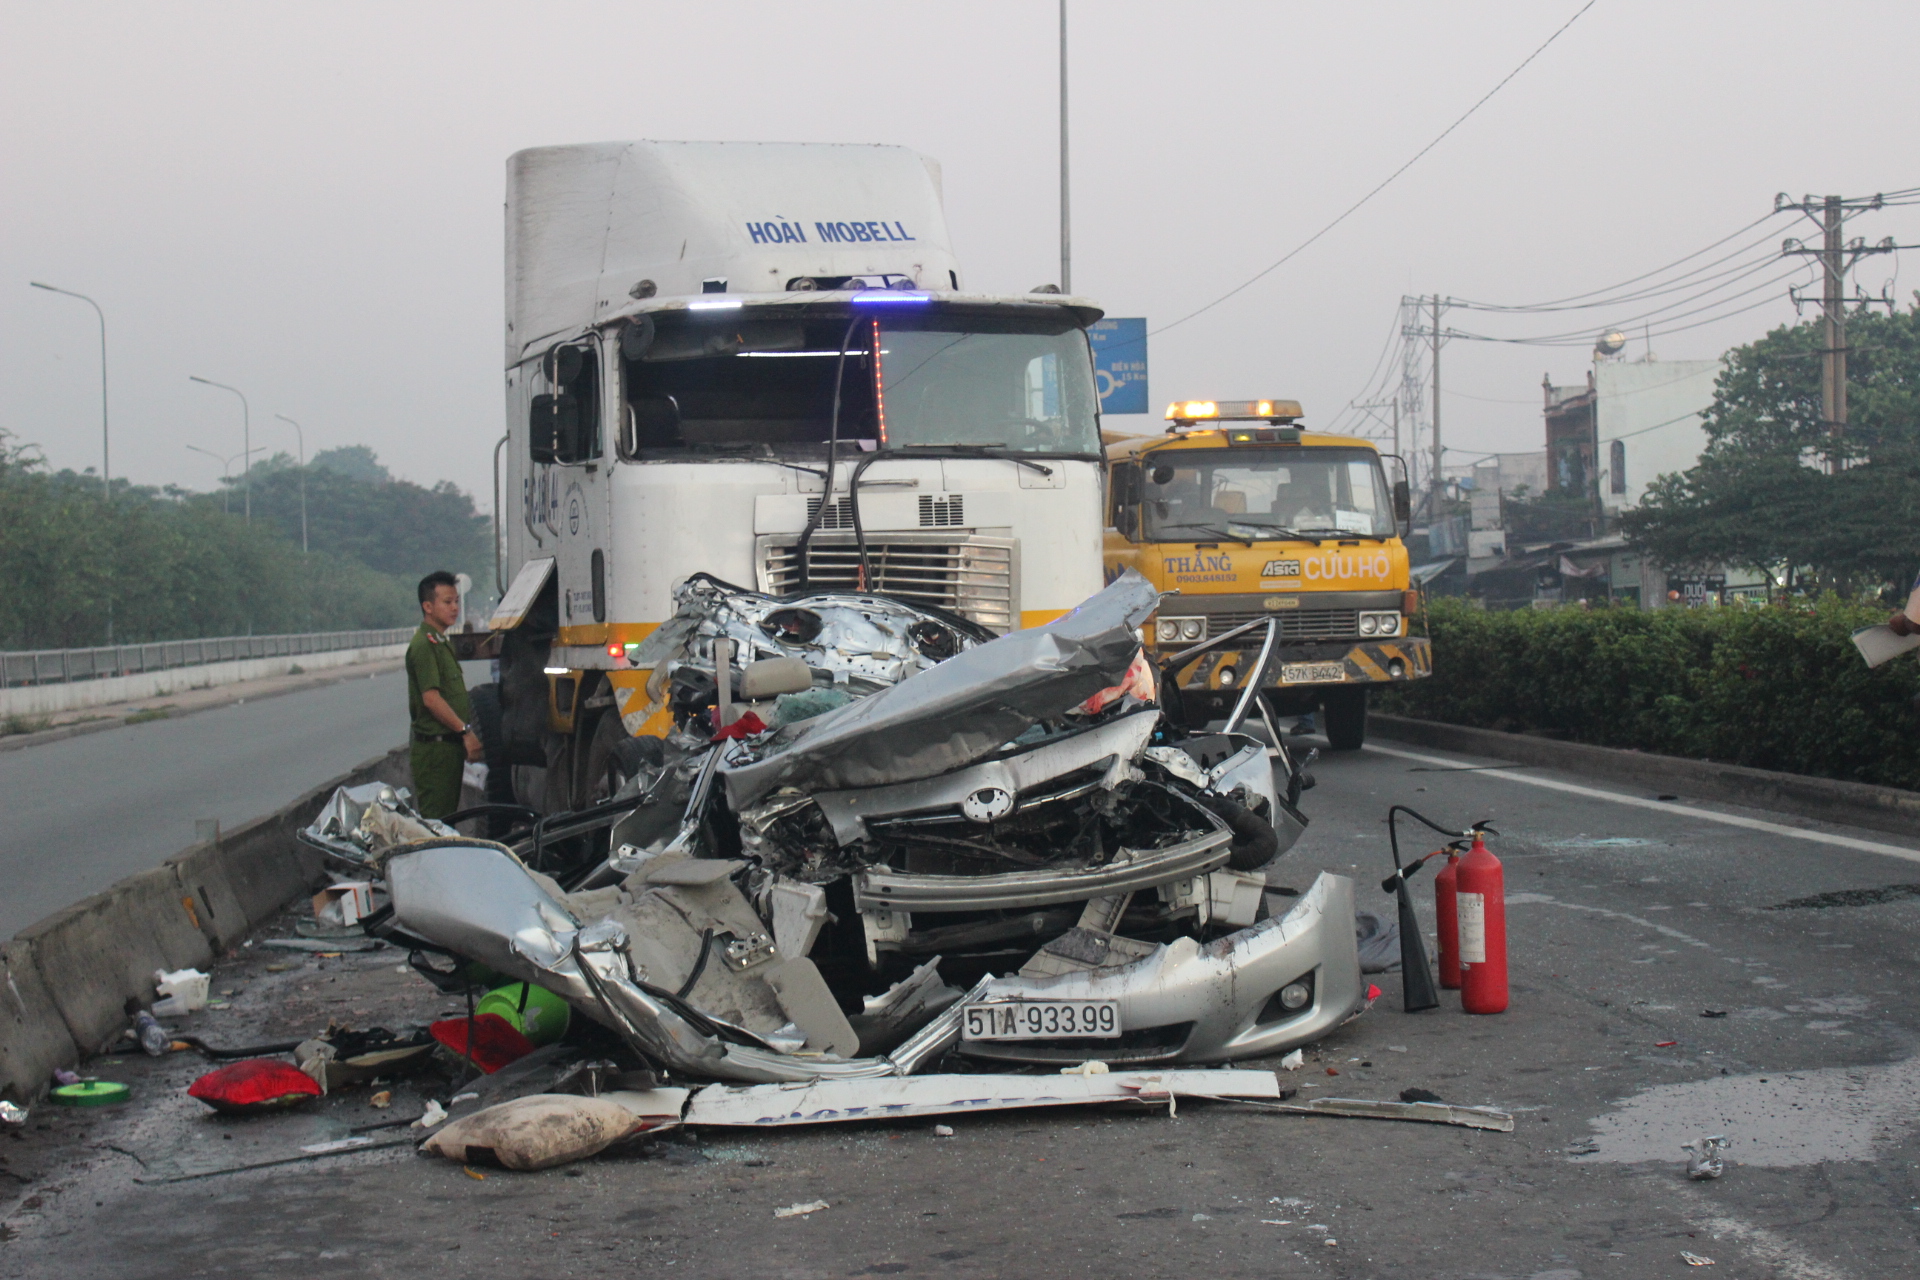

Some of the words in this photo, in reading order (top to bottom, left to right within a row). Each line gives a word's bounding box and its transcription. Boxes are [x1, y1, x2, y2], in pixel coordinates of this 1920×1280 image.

[746, 215, 807, 244] HOÀI
[814, 221, 916, 243] MOBELL
[1164, 550, 1232, 573] THẮNG
[968, 1005, 1114, 1036] 51A-933.99
